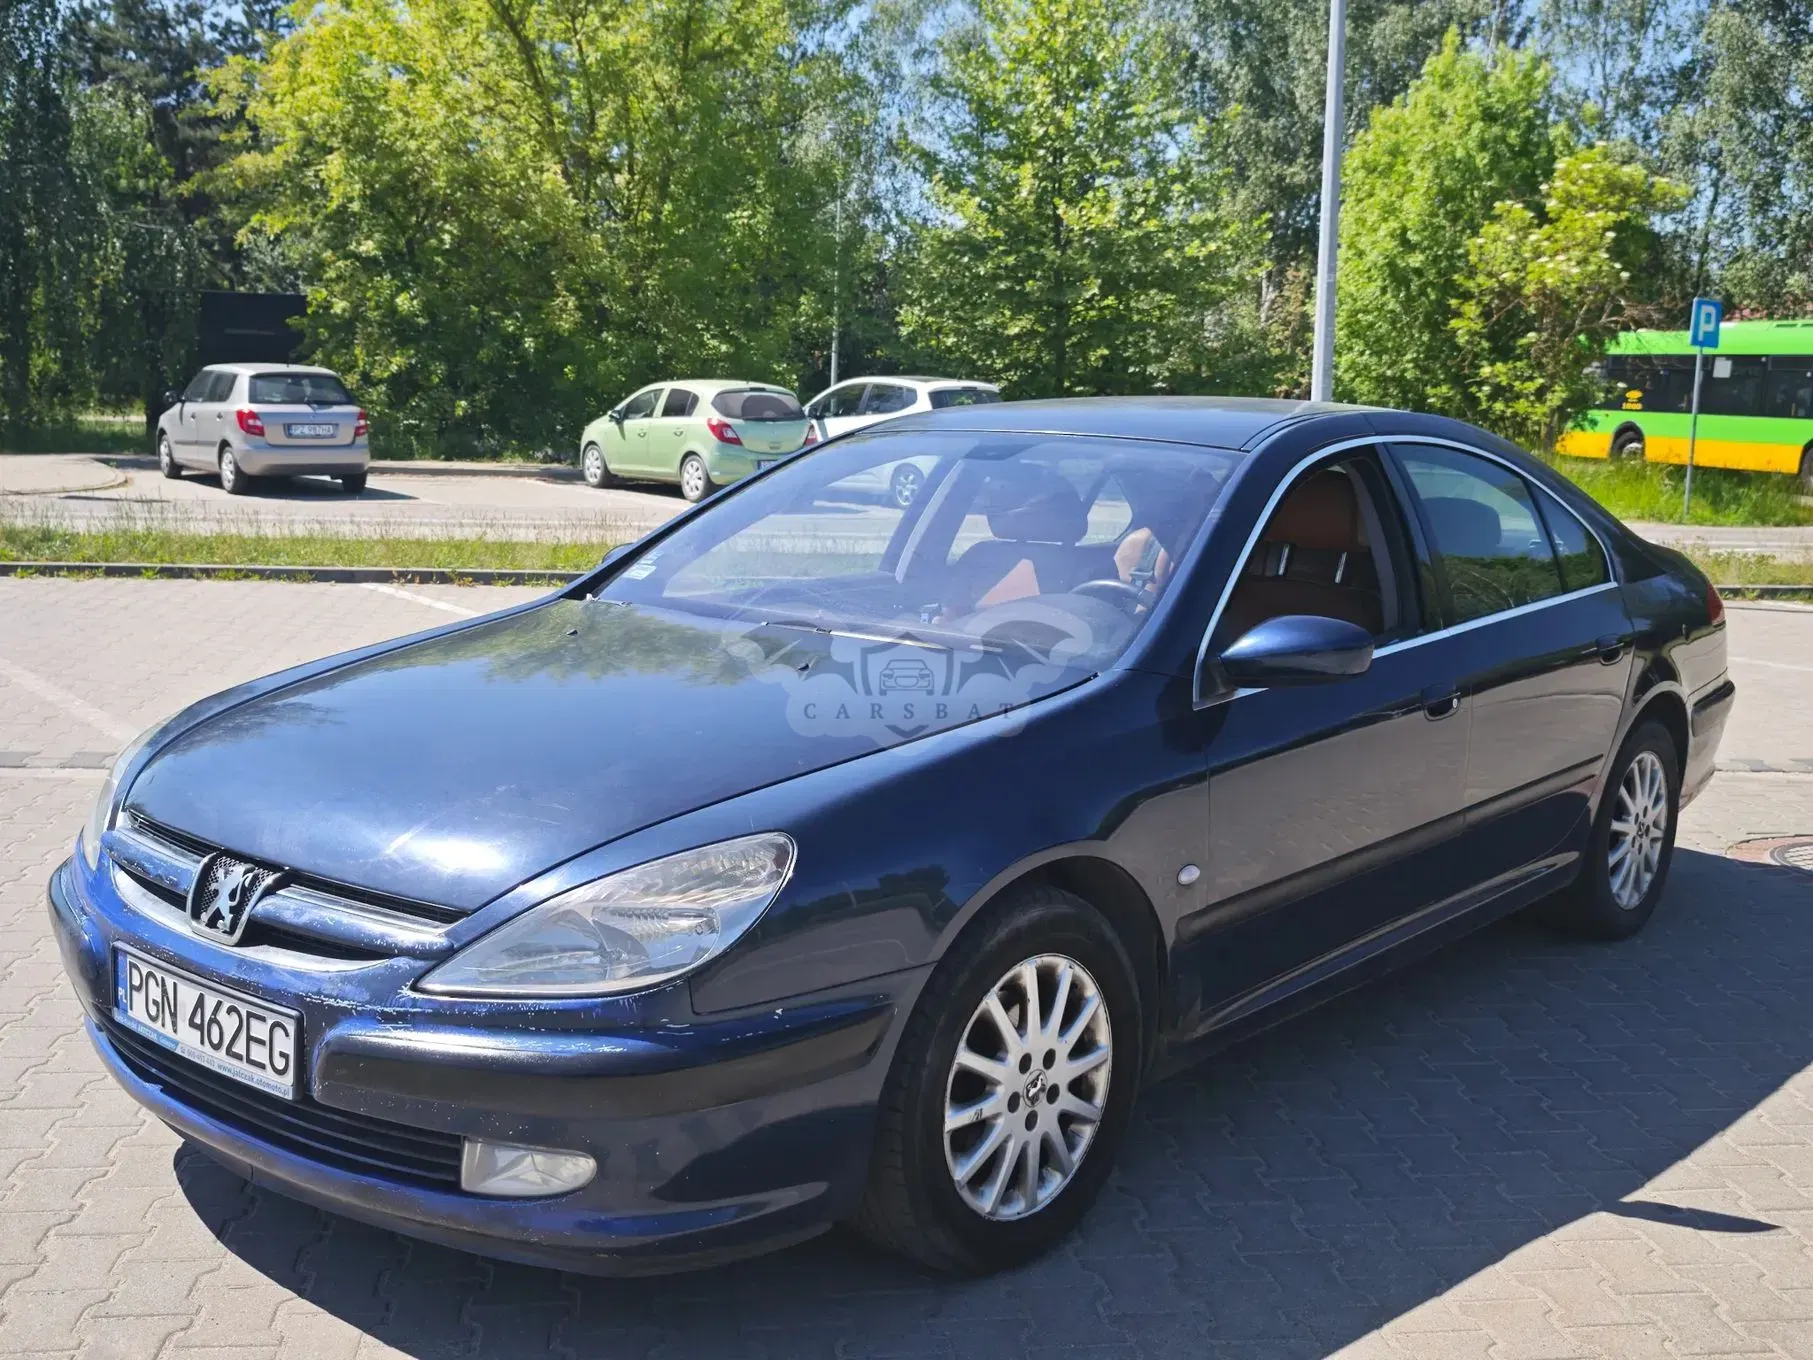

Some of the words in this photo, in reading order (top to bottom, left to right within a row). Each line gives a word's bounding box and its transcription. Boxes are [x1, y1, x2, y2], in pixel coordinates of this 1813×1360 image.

[1698, 304, 1716, 341] P
[118, 987, 127, 1003] PL
[128, 960, 178, 1034] PGN
[188, 992, 290, 1076] 462EG
